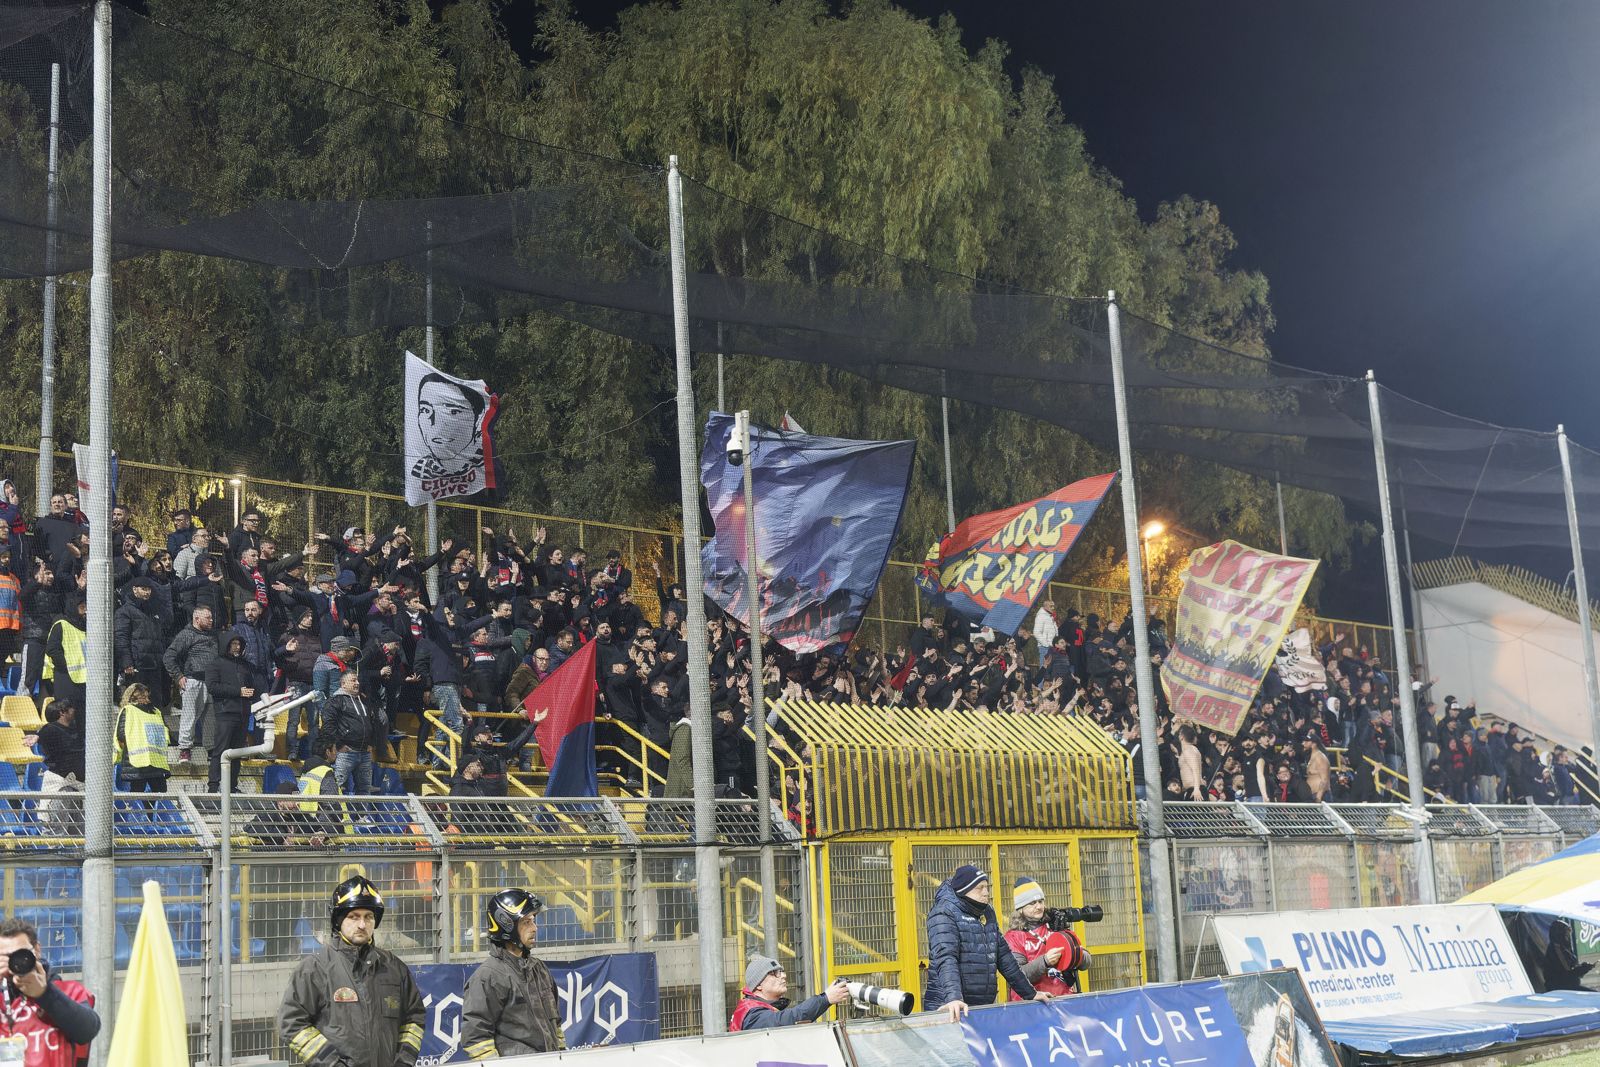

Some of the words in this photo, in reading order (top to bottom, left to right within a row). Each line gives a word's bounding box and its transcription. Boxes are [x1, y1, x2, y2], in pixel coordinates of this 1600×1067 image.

[431, 483, 469, 500] VIVE
[1292, 928, 1387, 973] PLINIO
[1393, 923, 1506, 973] Mimina
[1308, 975, 1356, 995] medical
[1356, 972, 1396, 989] center
[1475, 968, 1514, 993] group
[987, 1006, 1223, 1067] ITALYURE
